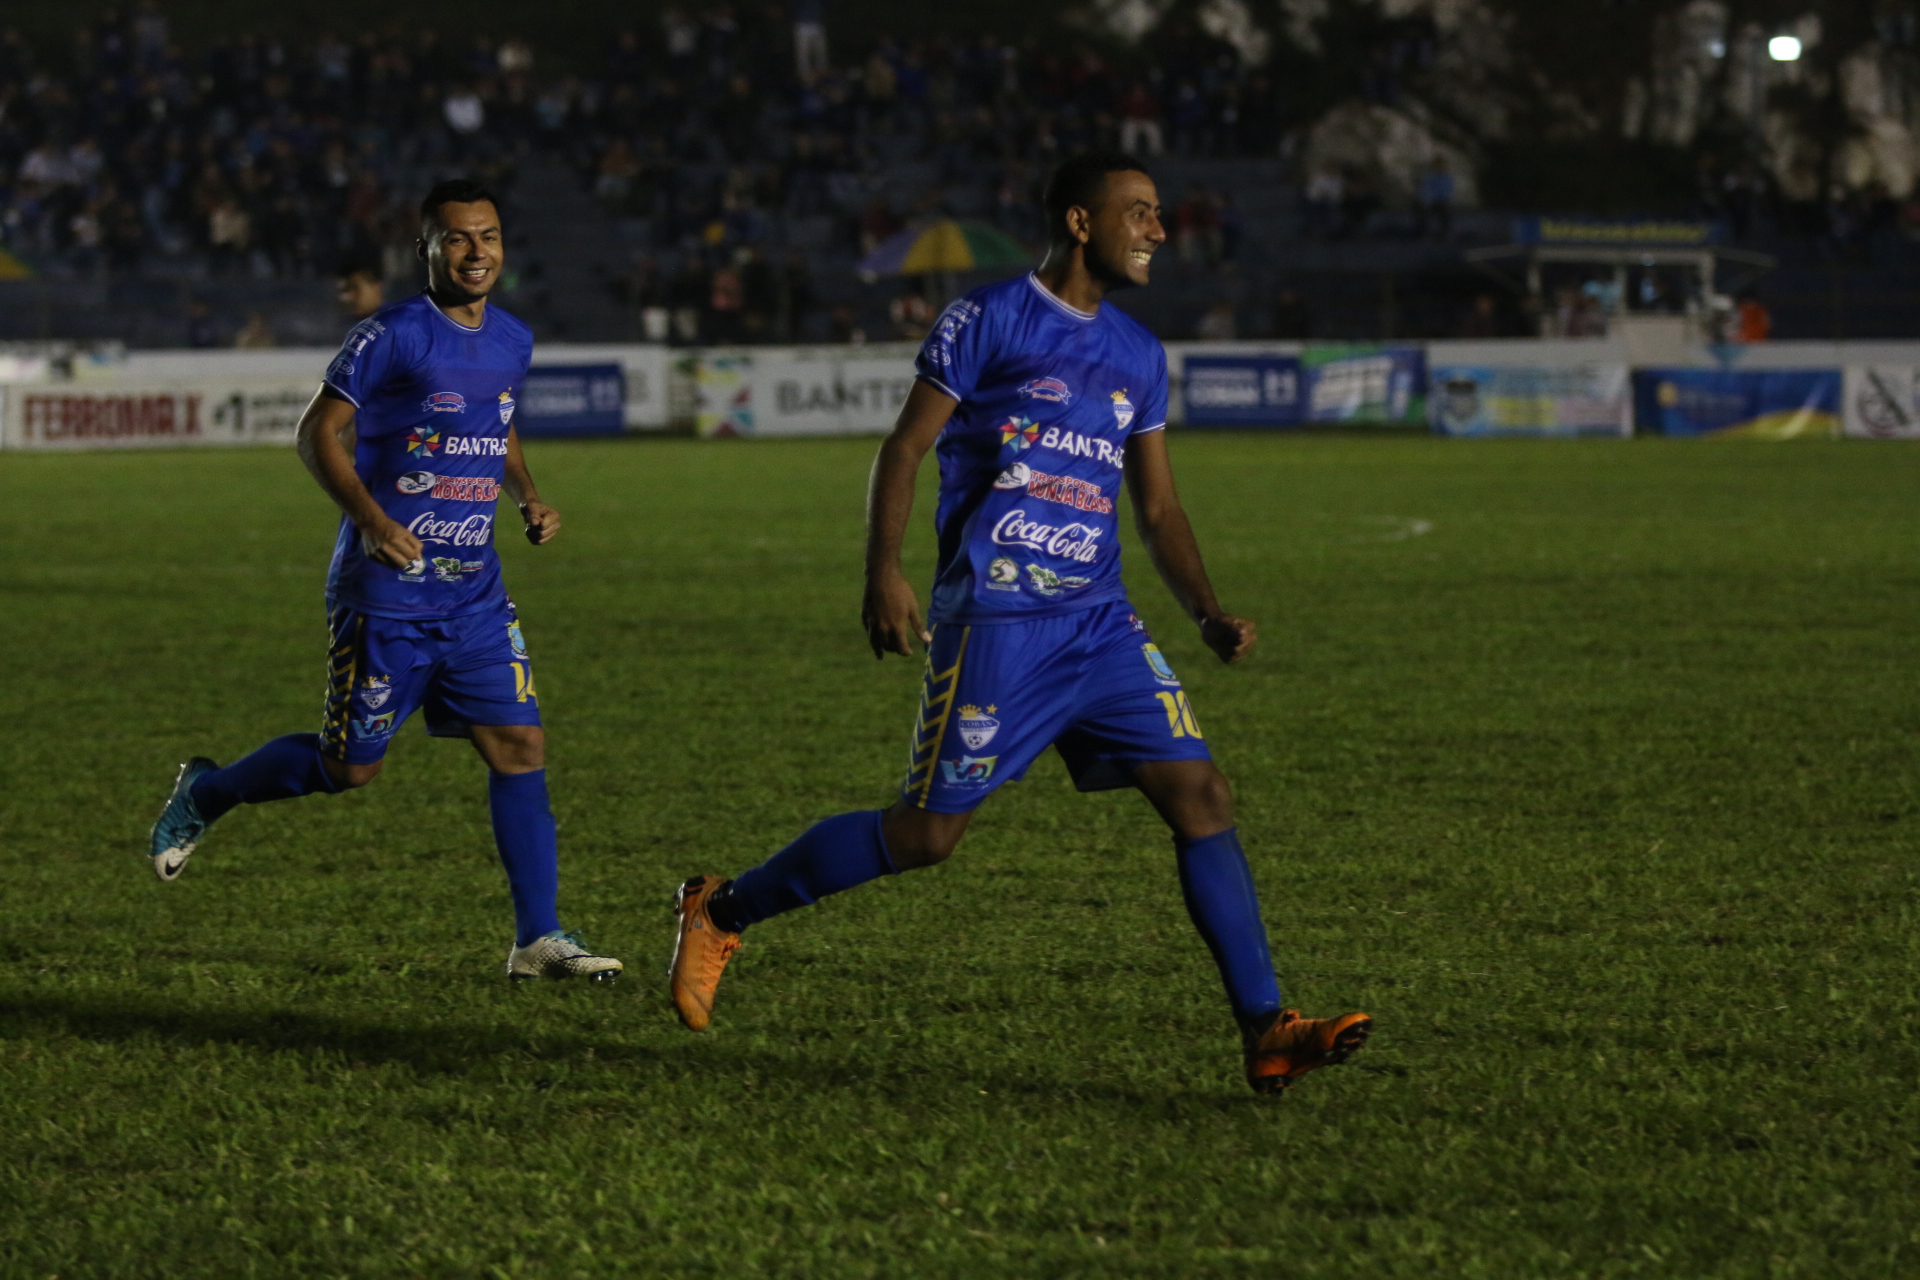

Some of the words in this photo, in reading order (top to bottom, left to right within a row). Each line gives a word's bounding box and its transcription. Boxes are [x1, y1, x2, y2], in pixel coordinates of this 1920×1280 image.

[431, 484, 473, 502] MONJA
[1031, 469, 1102, 496] TRANSPORTES
[407, 511, 493, 547] Coca-Cola
[991, 509, 1104, 563] Coca-Cola
[1154, 689, 1203, 739] 10
